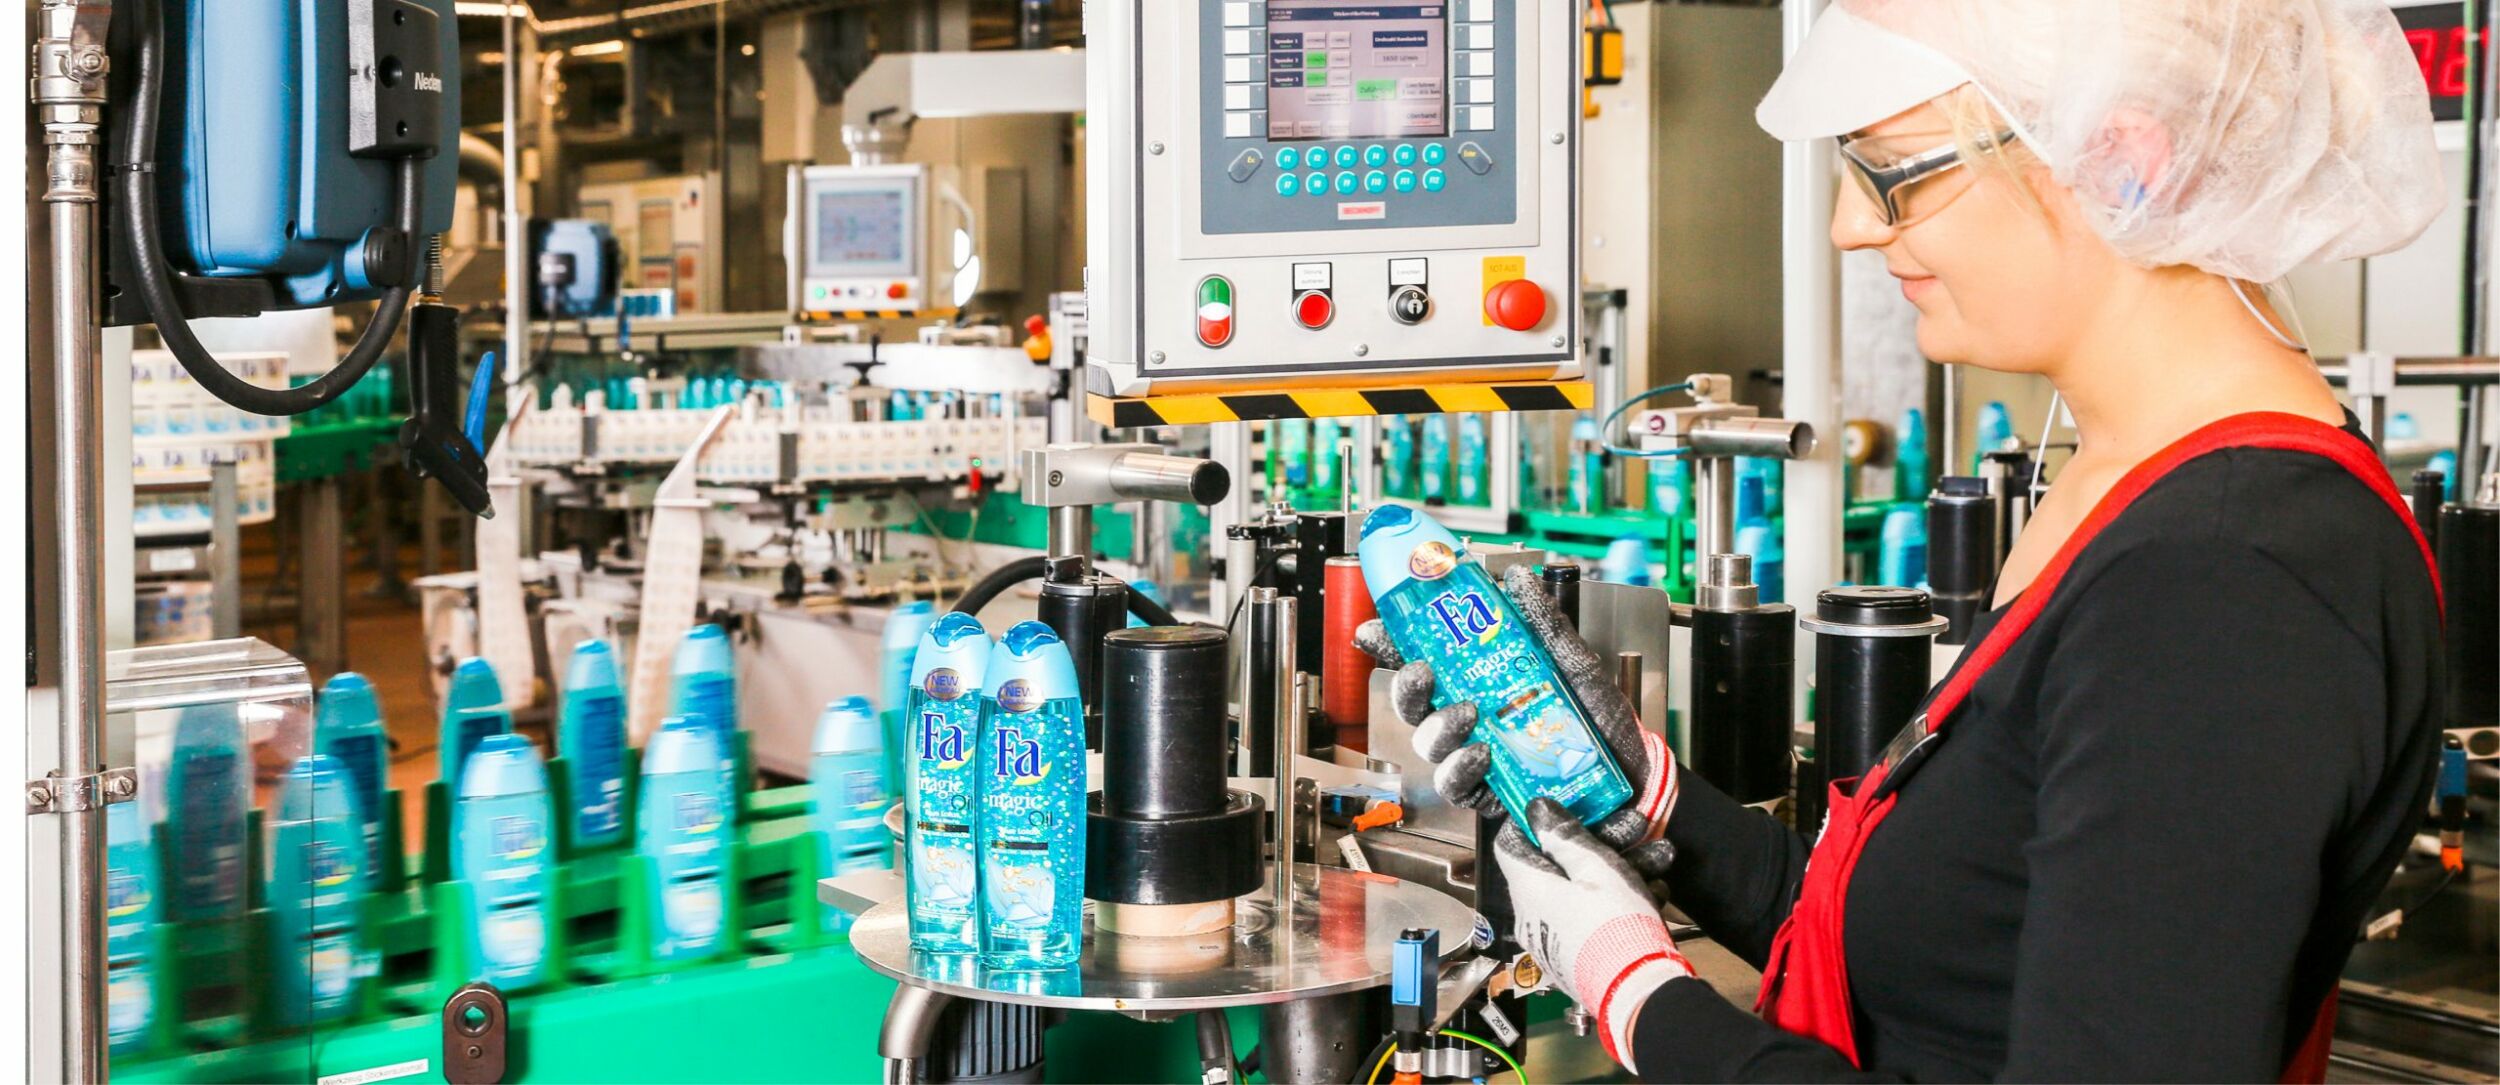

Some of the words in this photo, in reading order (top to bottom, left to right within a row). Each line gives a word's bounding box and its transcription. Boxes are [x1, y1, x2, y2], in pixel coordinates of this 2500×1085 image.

[1430, 593, 1500, 647] Fa
[931, 674, 959, 687] NEW
[1463, 645, 1520, 682] magic
[922, 713, 965, 763] Fa
[996, 728, 1042, 778] Fa
[988, 793, 1045, 817] magic
[1028, 810, 1053, 827] Oil
